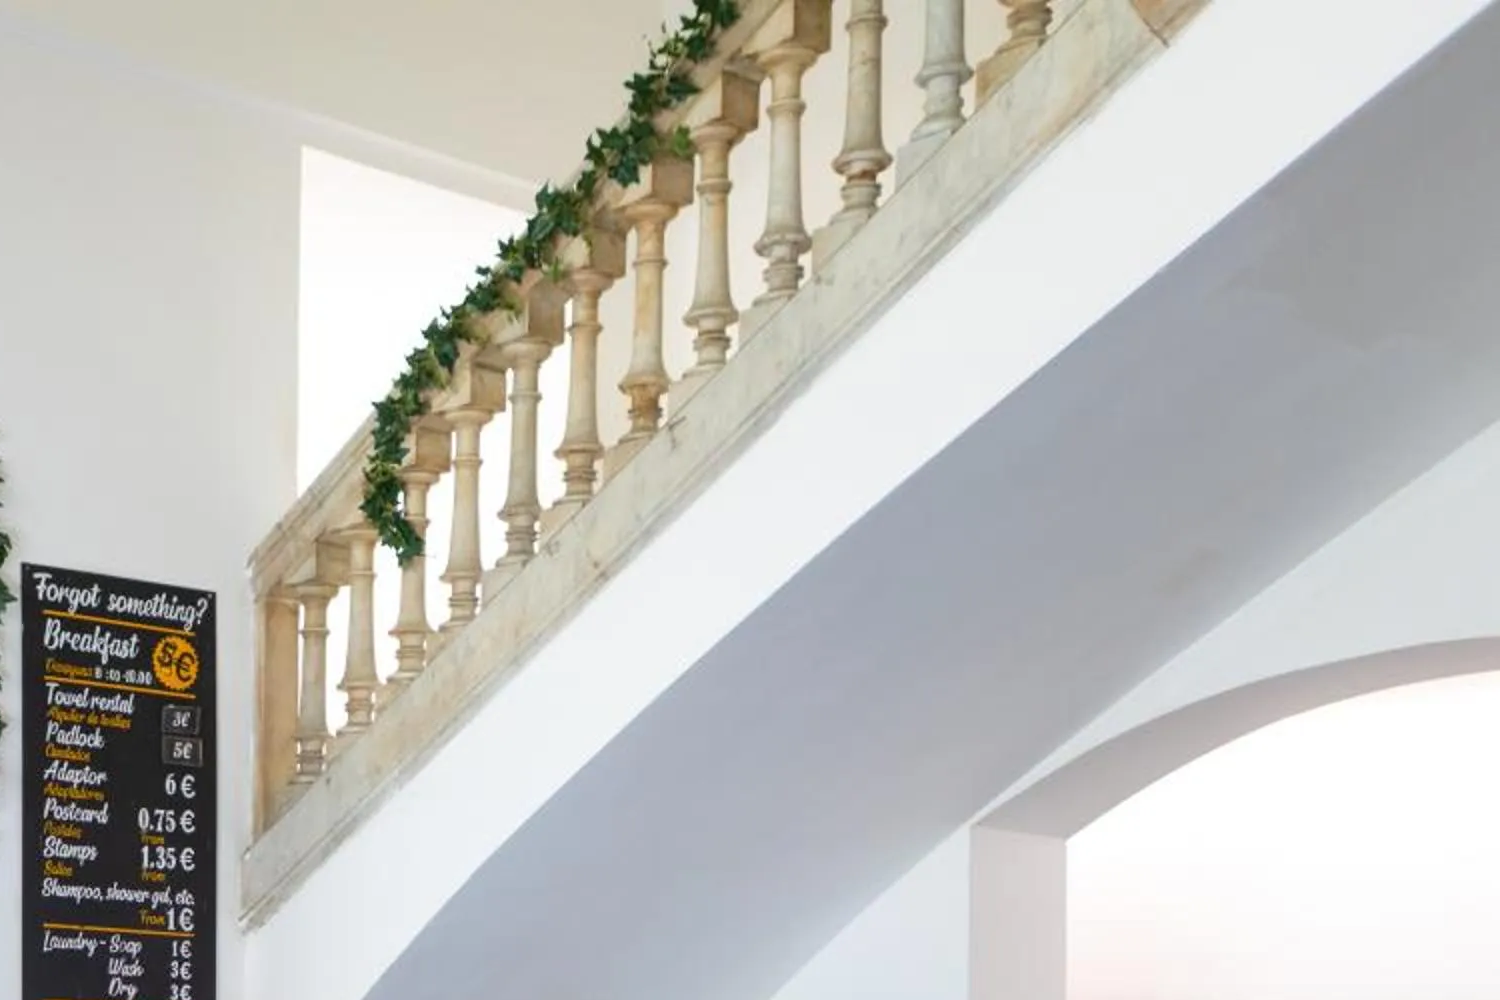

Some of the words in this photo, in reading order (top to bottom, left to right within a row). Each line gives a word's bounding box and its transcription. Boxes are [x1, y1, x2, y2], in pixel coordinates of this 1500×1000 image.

[33, 573, 100, 613] Forgot
[107, 592, 208, 631] something?
[43, 618, 140, 664] Breakfast
[45, 682, 89, 708] Towel
[90, 693, 135, 714] rental
[45, 720, 105, 749] Padlock
[44, 760, 108, 788] Adaptor
[44, 797, 109, 824] Postcard
[43, 835, 99, 867] Stamps
[106, 883, 150, 902] shower
[43, 931, 98, 956] Laundry
[109, 935, 142, 955] Soap
[108, 957, 144, 978] Wash
[108, 978, 138, 1000] Dry
